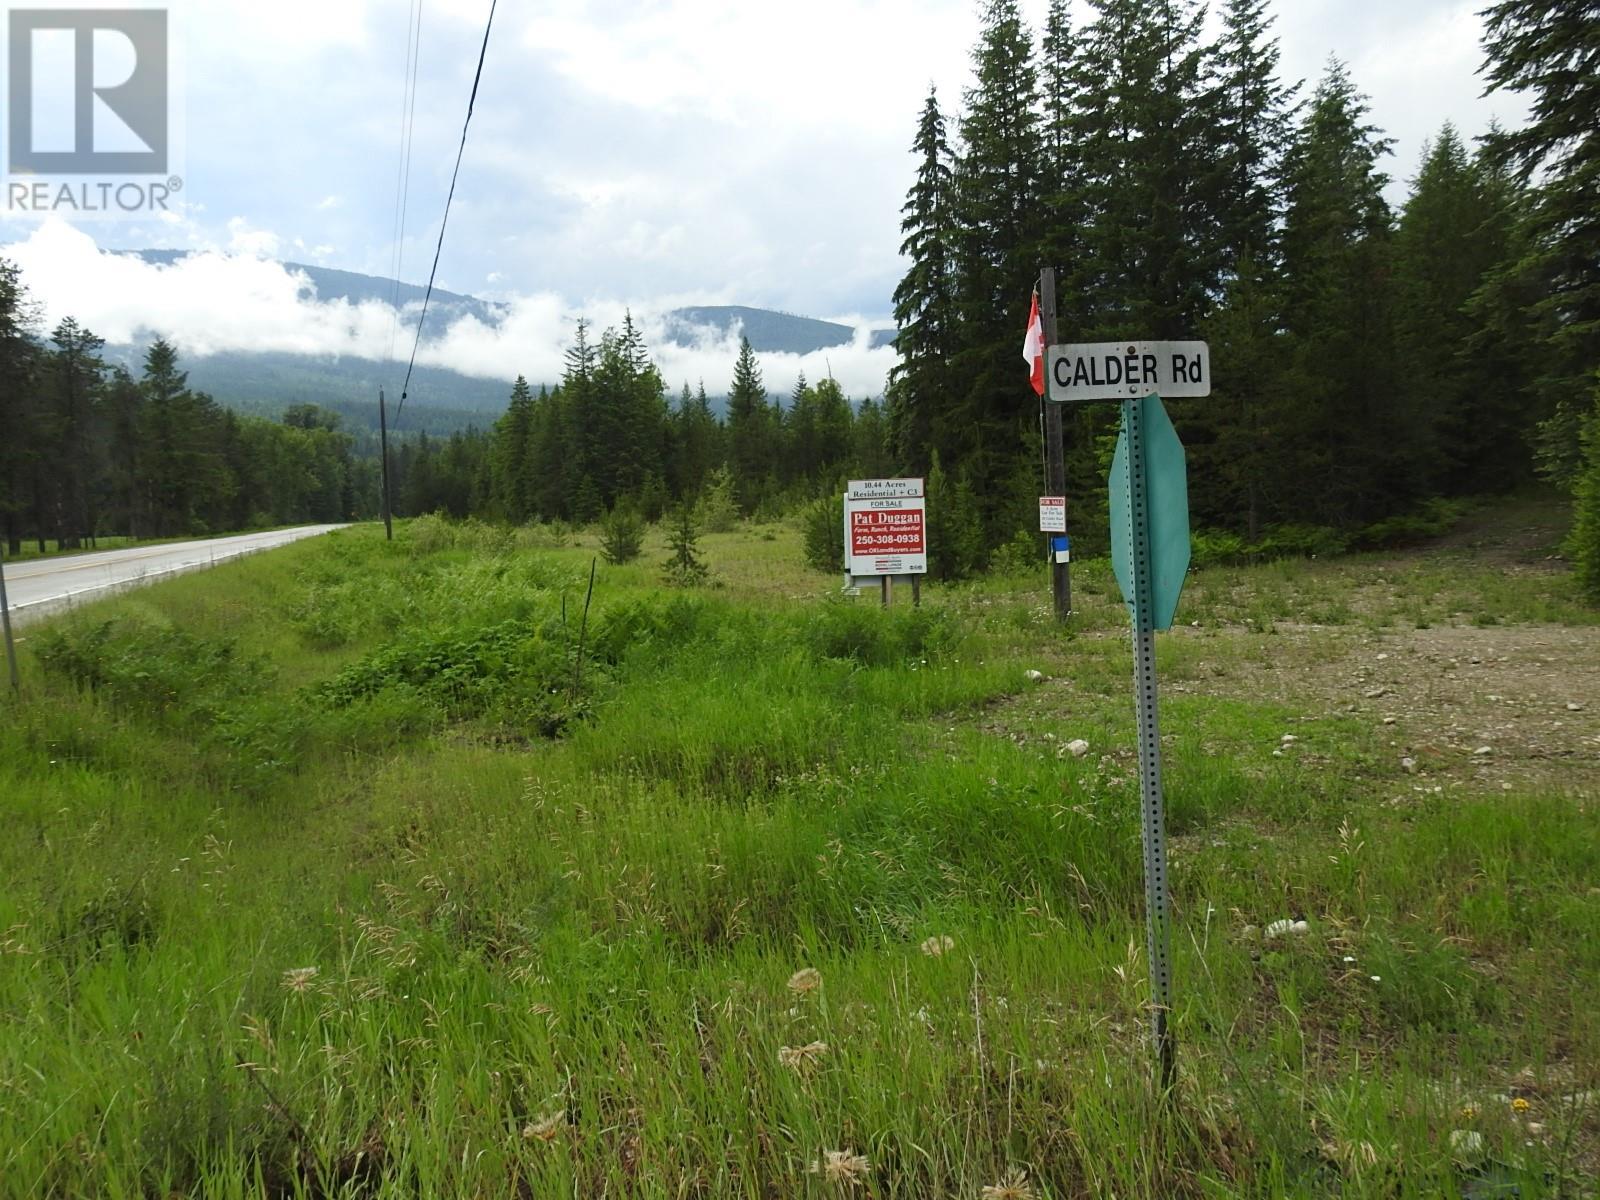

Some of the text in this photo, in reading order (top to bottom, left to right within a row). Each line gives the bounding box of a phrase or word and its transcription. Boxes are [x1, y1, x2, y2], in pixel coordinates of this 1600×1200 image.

[1054, 354, 1202, 387] CALDER Rd
[853, 489, 896, 498] Residential
[854, 513, 921, 524] Pat Duggan
[856, 535, 920, 544] 250-308-0938
